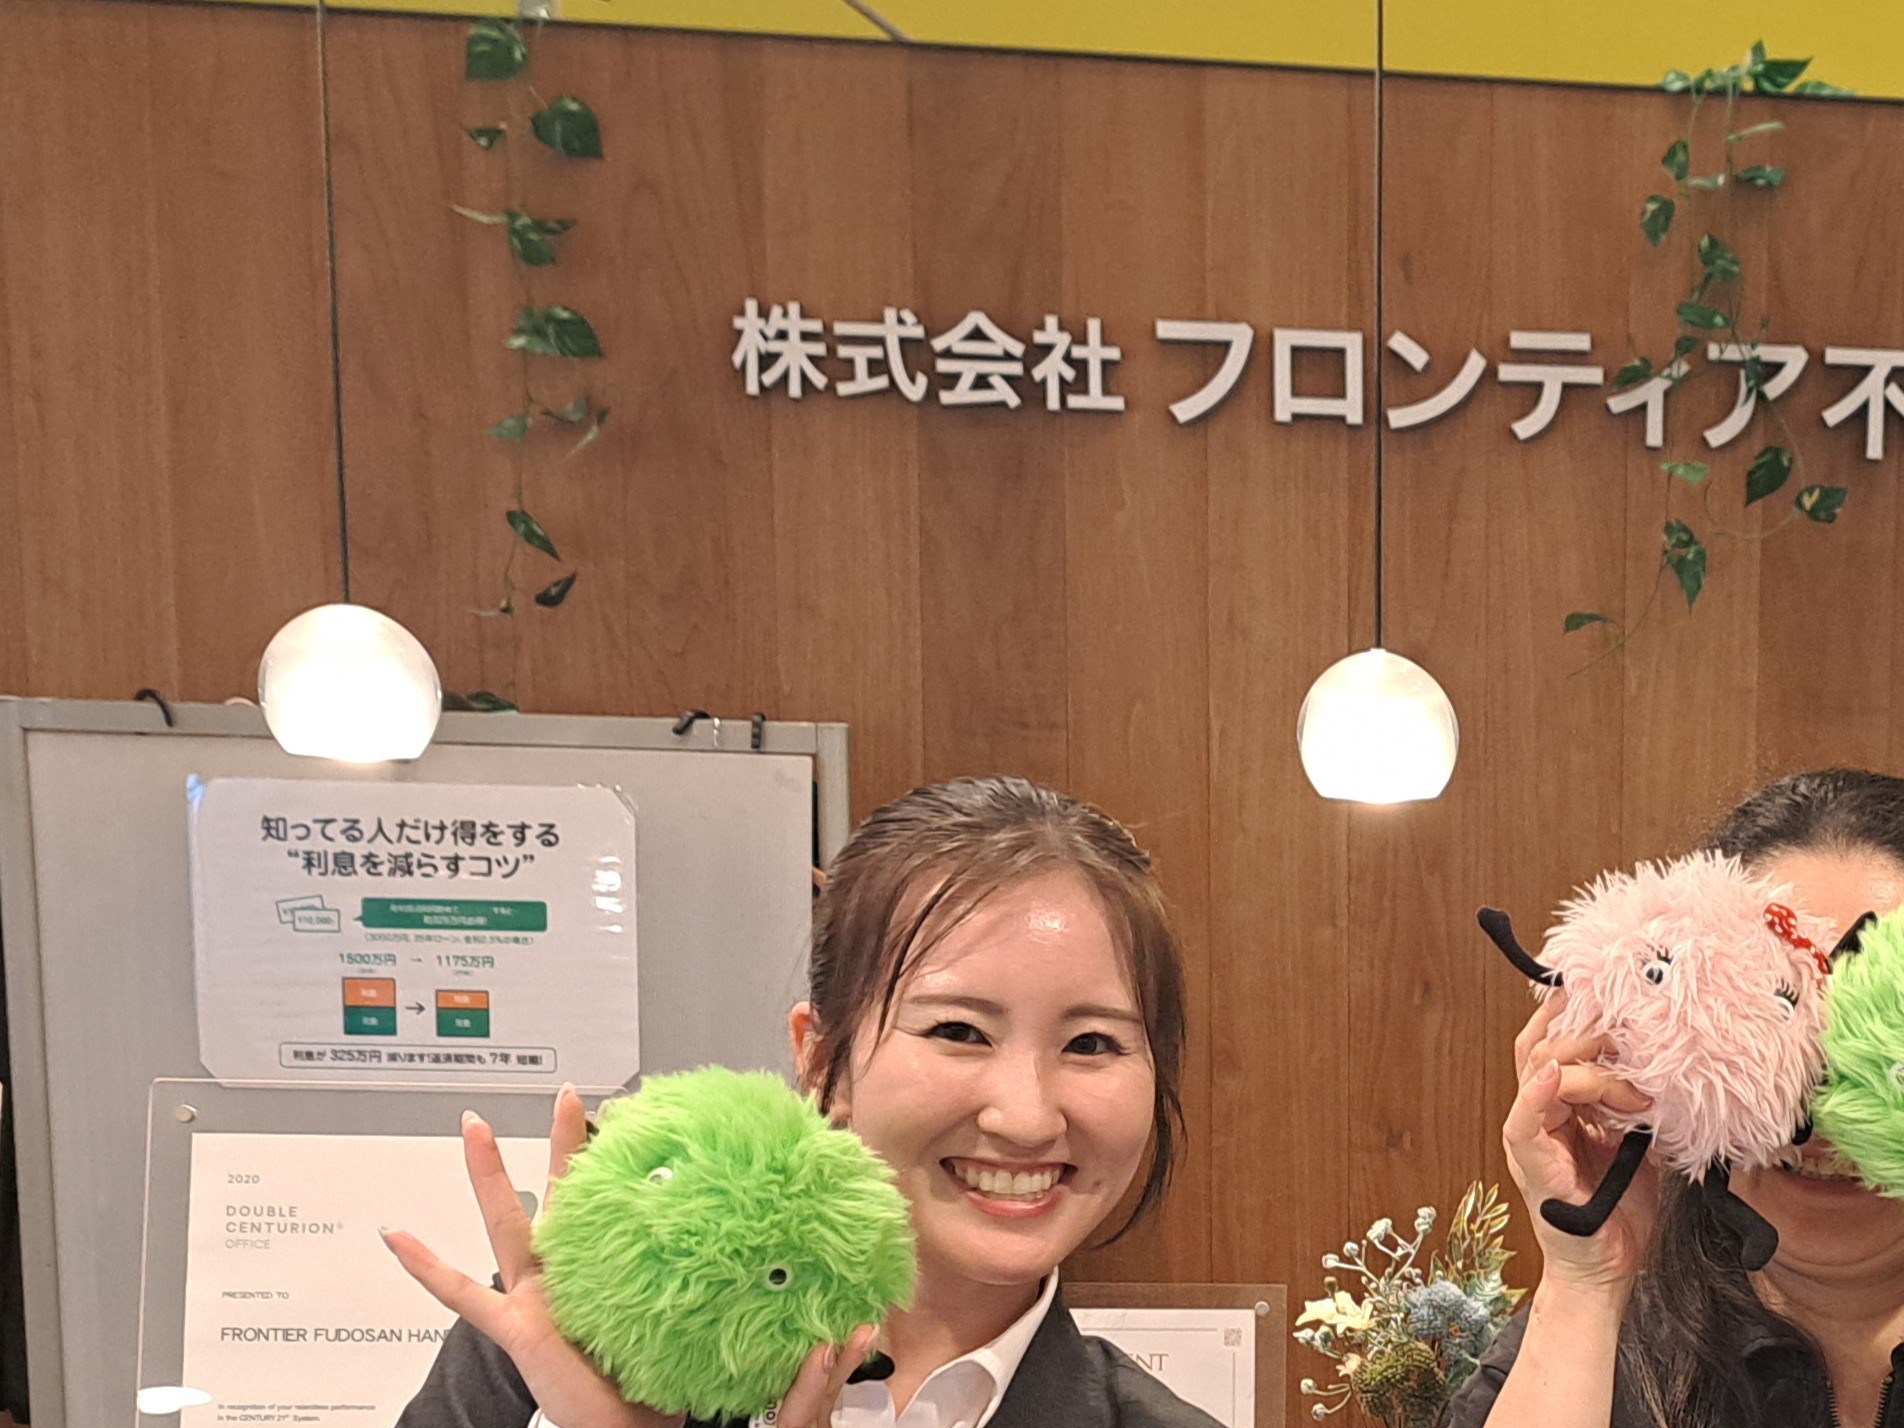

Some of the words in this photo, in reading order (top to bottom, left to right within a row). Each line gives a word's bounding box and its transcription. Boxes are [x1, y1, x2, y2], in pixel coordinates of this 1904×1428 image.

[731, 297, 1126, 412] 株式会社
[260, 814, 561, 848] 知ってる人だけ得をする
[338, 953, 397, 967] 1500万円
[436, 954, 495, 968] 1175万円
[227, 1174, 260, 1184] 2020
[226, 1205, 299, 1218] DOUBLE
[225, 1238, 271, 1249] OFFICE
[222, 1291, 273, 1300] PRESENTED
[276, 1291, 290, 1300] TO
[220, 1327, 308, 1342] FRONTIER
[313, 1328, 402, 1343] FUDOSAN
[408, 1328, 452, 1343] HAN
[277, 1404, 294, 1413] your
[226, 1414, 238, 1422] the
[239, 1414, 275, 1422] CENTURY
